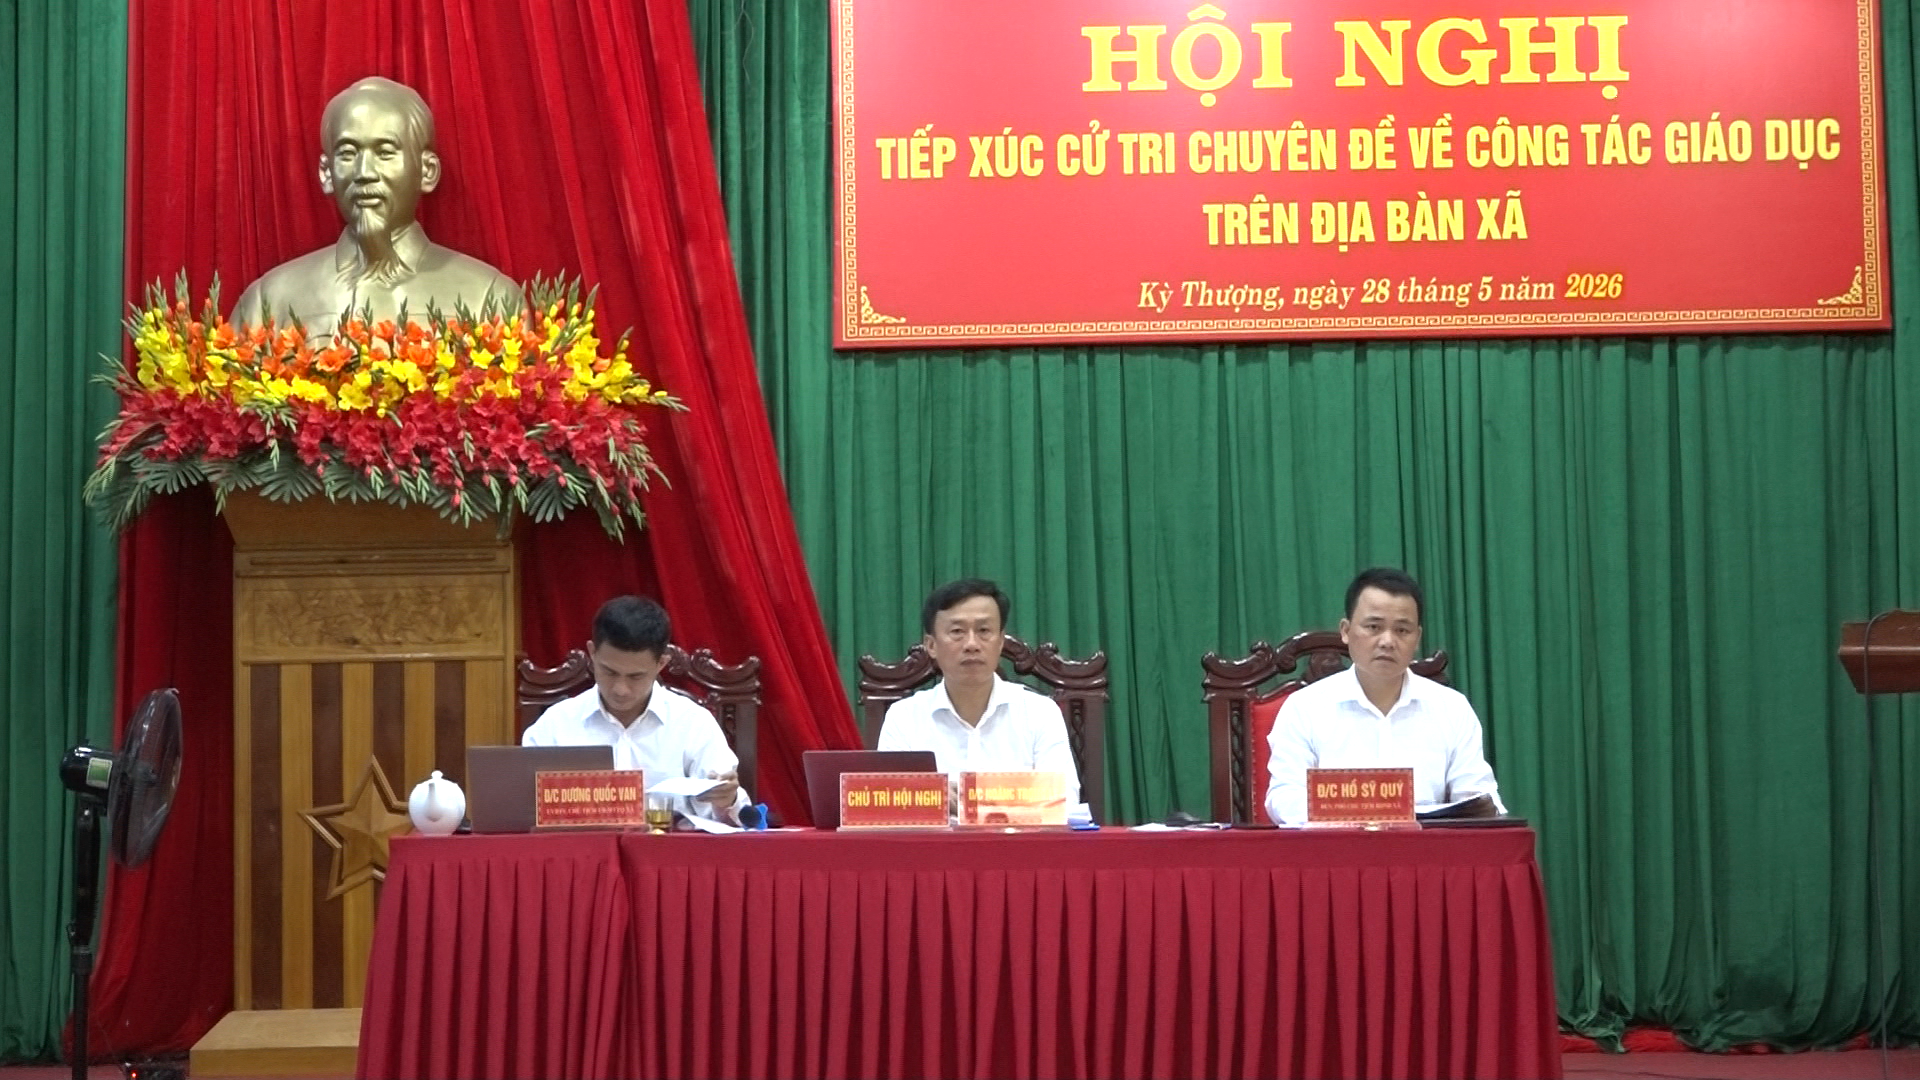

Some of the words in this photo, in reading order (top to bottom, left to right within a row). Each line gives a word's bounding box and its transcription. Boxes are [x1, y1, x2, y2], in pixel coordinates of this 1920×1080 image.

[1081, 5, 1293, 108] HỘI
[1333, 15, 1630, 100] NGHỊ
[876, 123, 956, 180] TIẾP
[969, 126, 1044, 178] XÚC
[1056, 120, 1110, 176] CỬ
[1118, 132, 1176, 175] TRI
[1188, 120, 1338, 174] CHUYÊN
[1348, 114, 1397, 170] ĐỀ
[1408, 113, 1454, 169] VỀ
[1465, 116, 1570, 168] CÔNG
[1580, 114, 1652, 166] TÁC
[1664, 112, 1753, 164] GIÁO
[1764, 118, 1841, 170] DỤC
[1202, 194, 1300, 246] TRÊN
[1310, 200, 1376, 254] ĐỊA
[1385, 191, 1465, 242] BÀN
[1476, 189, 1528, 240] XÃ
[1137, 281, 1173, 313] Kỳ
[1181, 280, 1285, 313] Thượng,
[1292, 280, 1356, 314] ngày
[1361, 278, 1392, 304] 28
[1397, 276, 1473, 307] tháng
[1477, 275, 1494, 302] 5
[1499, 277, 1556, 302] năm
[1564, 272, 1625, 301] 2026
[593, 782, 617, 804] QUỐC
[848, 785, 870, 807] CHỦ
[872, 787, 890, 807] TRÌ
[893, 787, 912, 809] HỘI
[915, 790, 942, 809] NGHỊ
